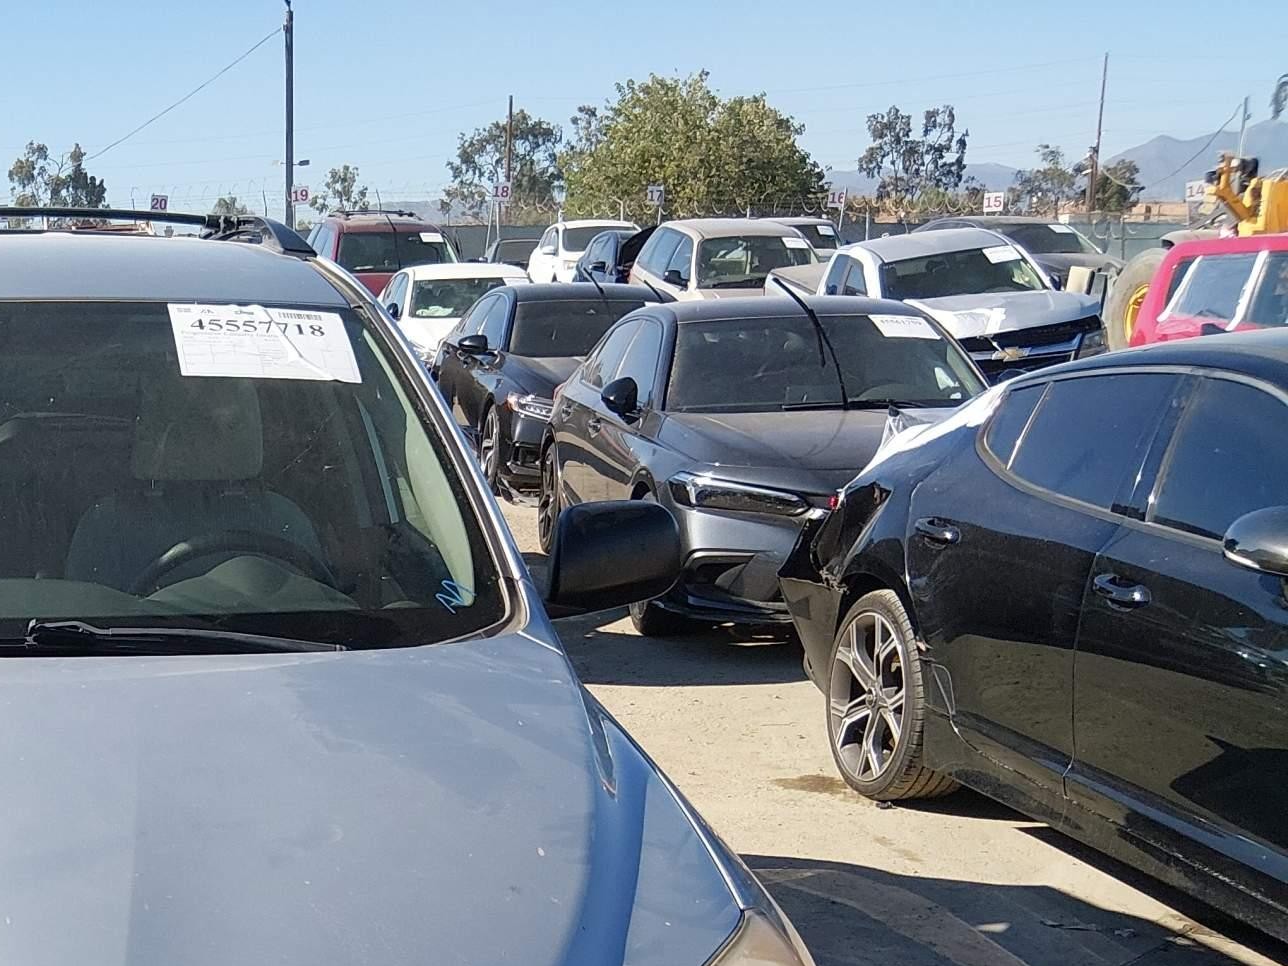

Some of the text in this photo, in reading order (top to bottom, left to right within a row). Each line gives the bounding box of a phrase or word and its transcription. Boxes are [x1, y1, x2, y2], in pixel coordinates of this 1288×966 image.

[293, 189, 309, 202] 19
[494, 186, 509, 198] 18
[649, 189, 662, 202] 17
[152, 197, 167, 210] 20
[985, 196, 1002, 209] 15
[190, 317, 326, 338] 45557718
